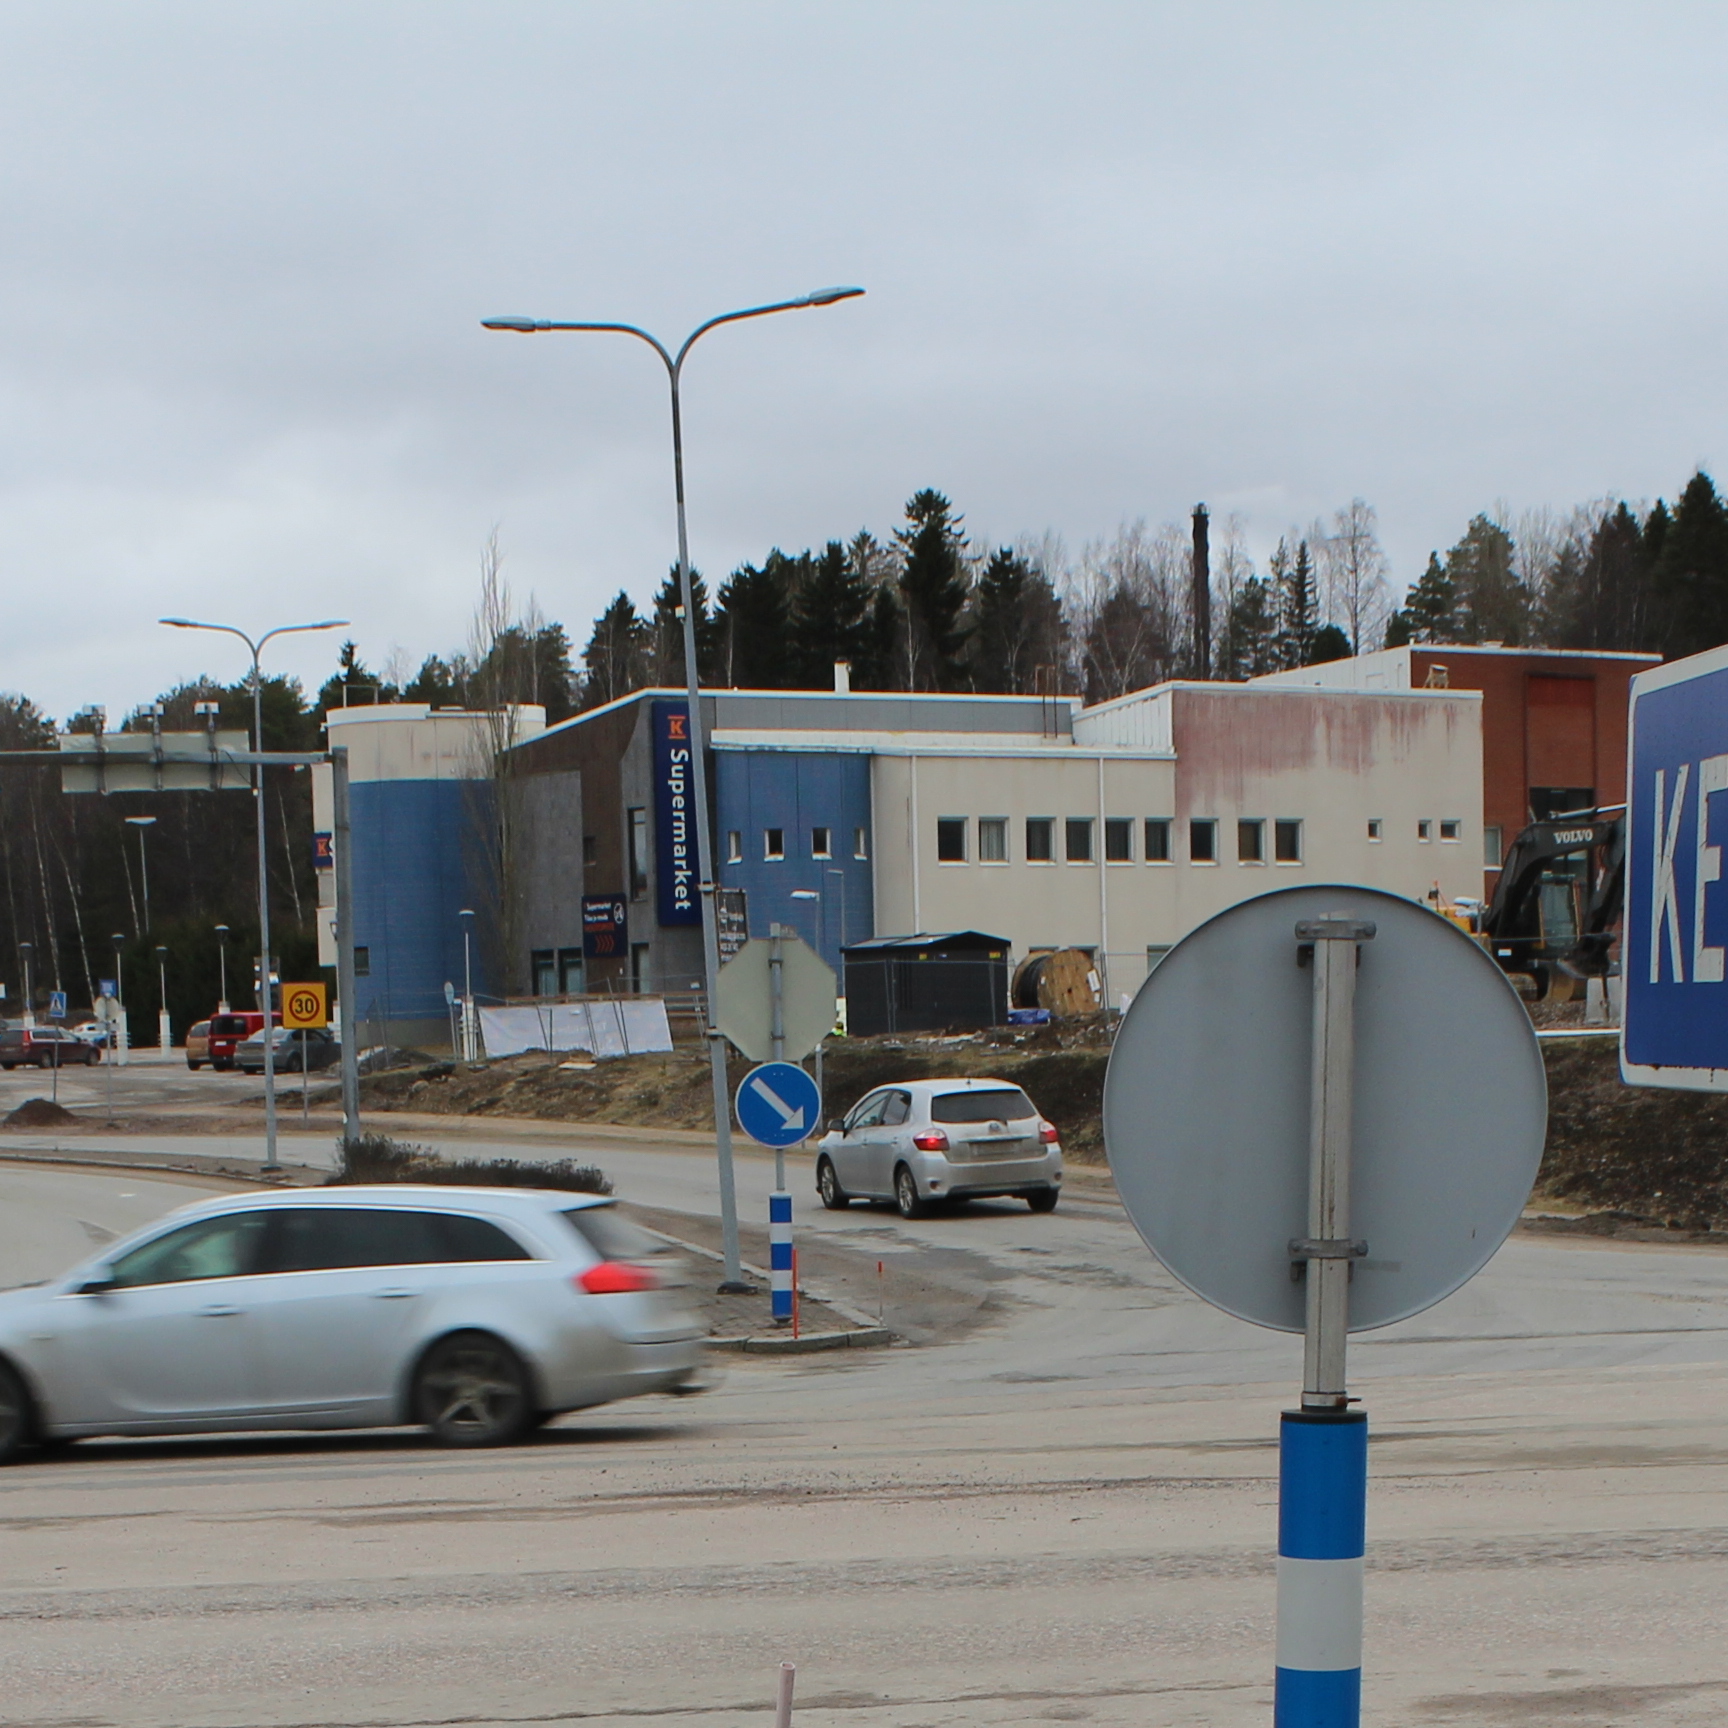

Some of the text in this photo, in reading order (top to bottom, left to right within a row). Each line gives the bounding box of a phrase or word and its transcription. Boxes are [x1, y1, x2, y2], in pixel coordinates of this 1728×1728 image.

[668, 748, 692, 910] Supermarket
[1554, 829, 1593, 844] VOLVO
[295, 998, 314, 1014] 30
